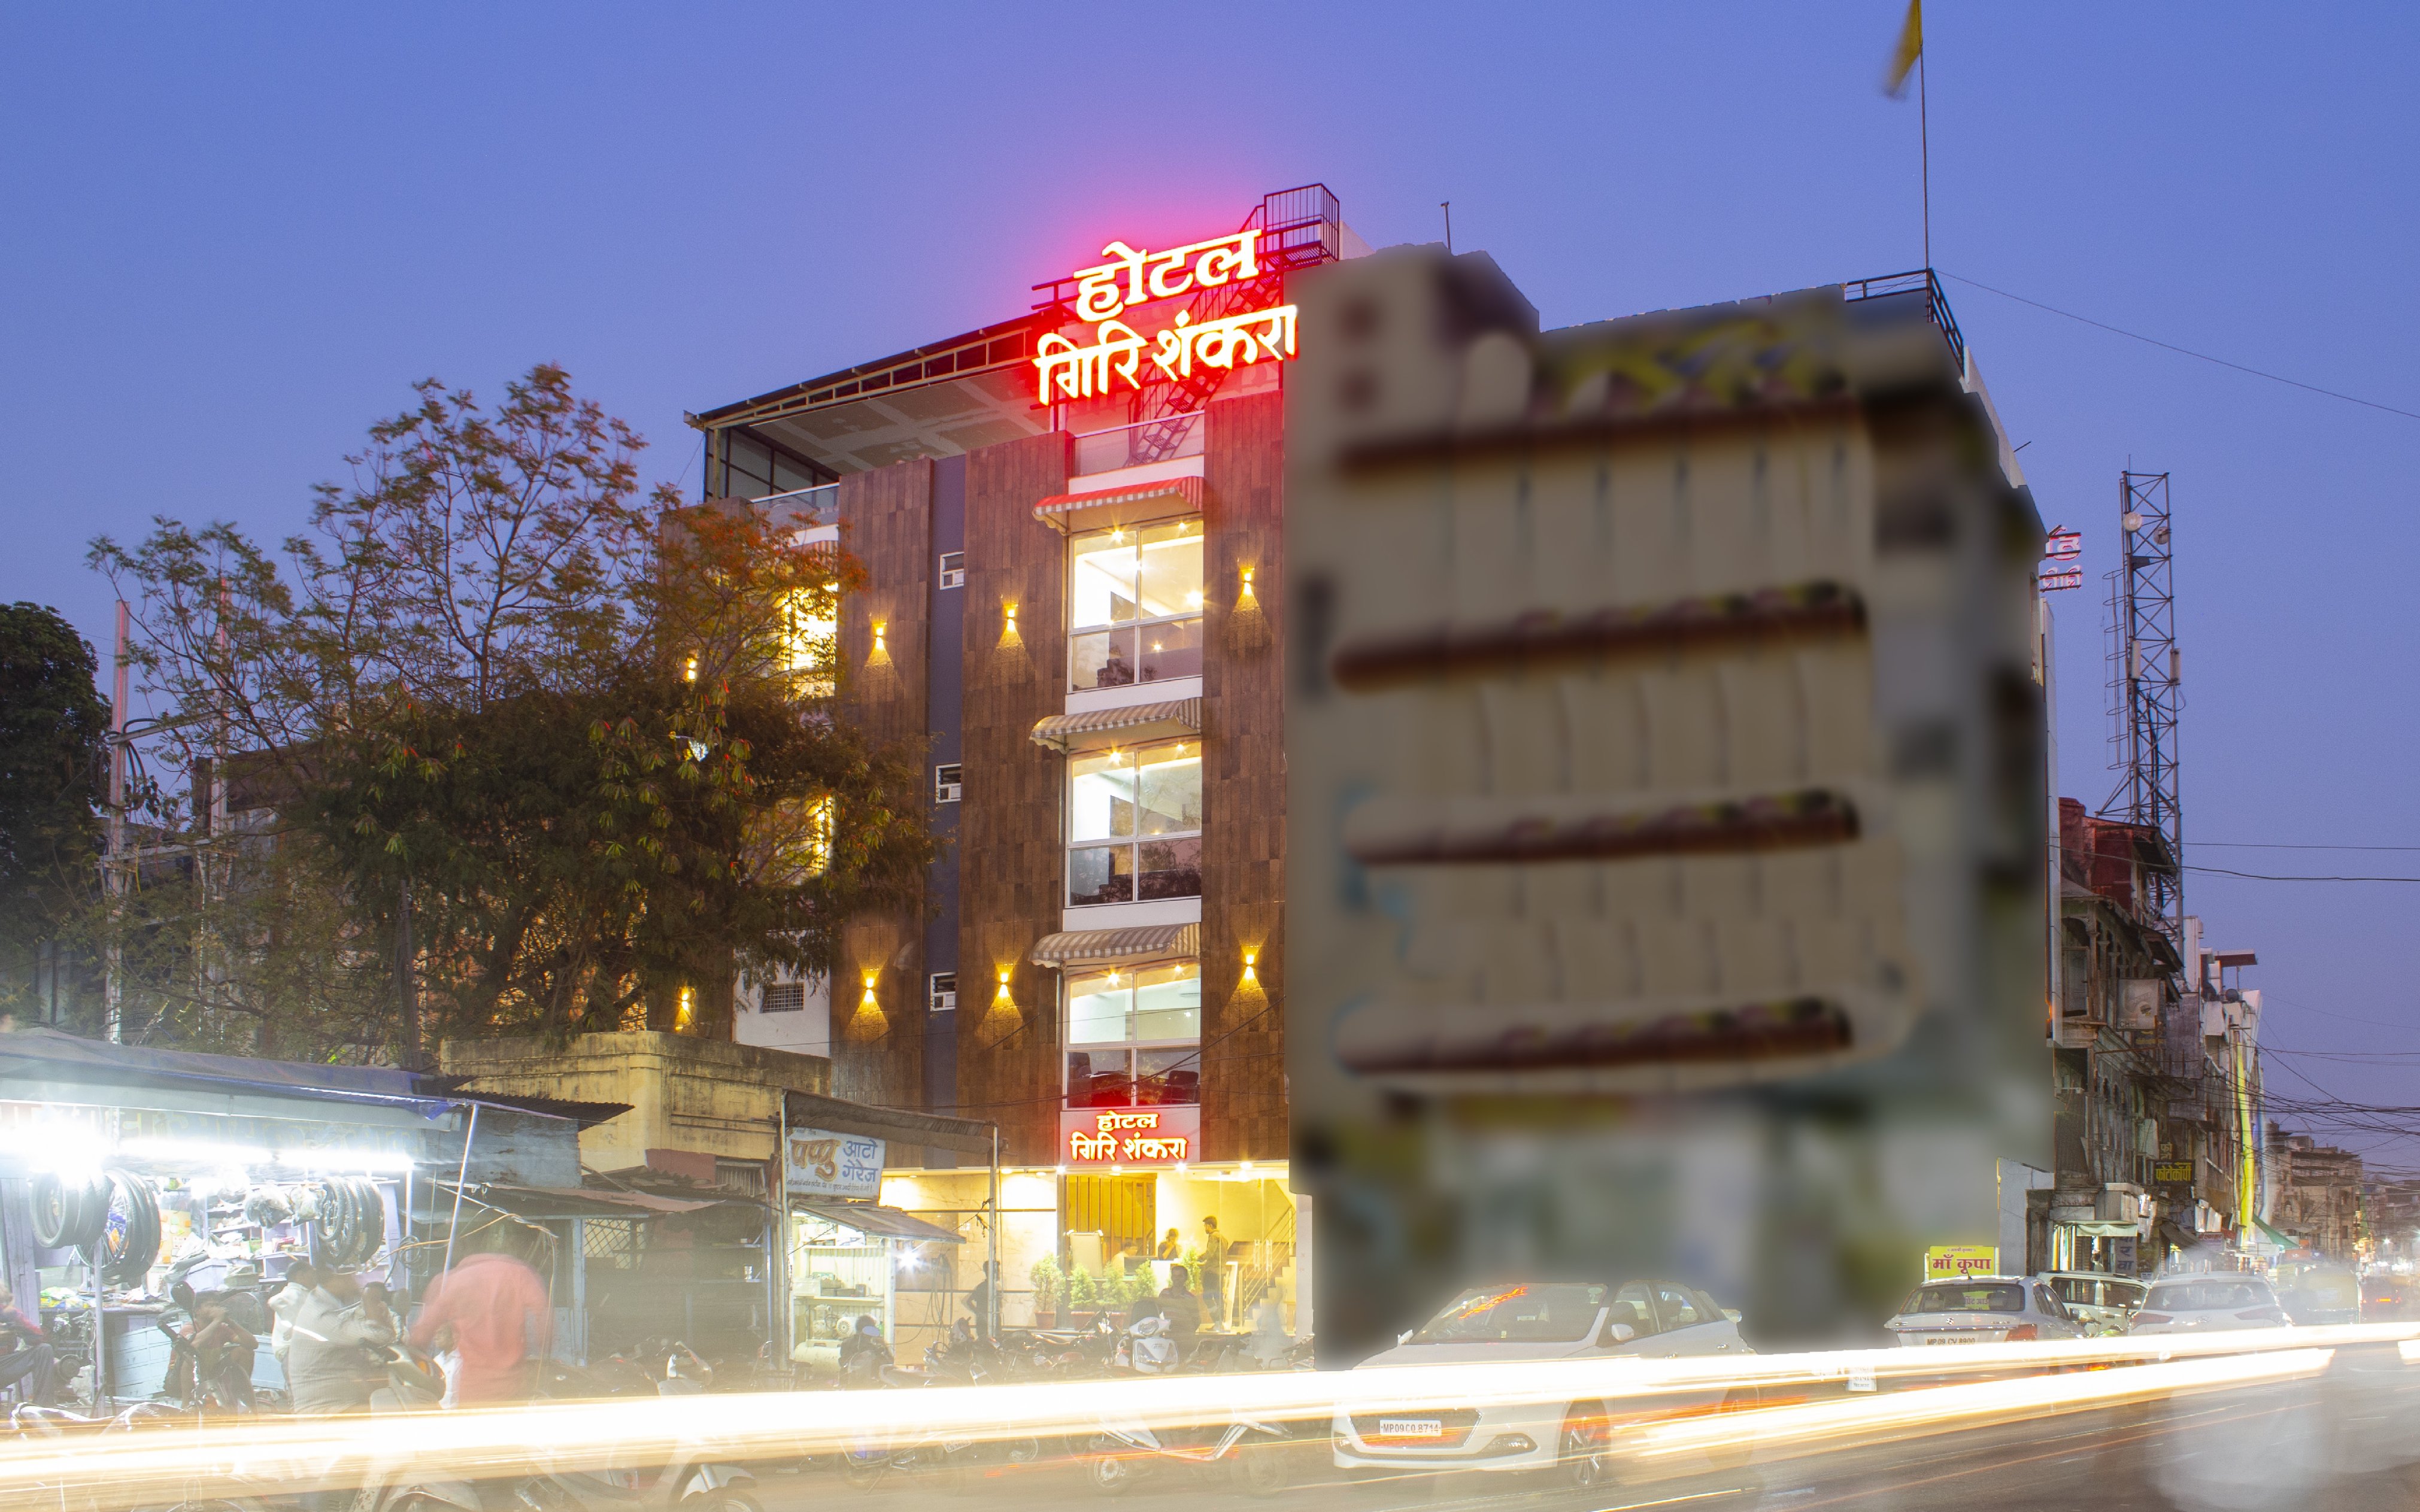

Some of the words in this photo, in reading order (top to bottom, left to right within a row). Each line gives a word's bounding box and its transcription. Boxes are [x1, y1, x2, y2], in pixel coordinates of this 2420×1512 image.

[1073, 229, 1261, 322] होटल
[1032, 320, 1148, 406] गिरि
[1151, 304, 1298, 382] शंकरा
[1096, 1110, 1159, 1133] होटल
[1069, 1131, 1119, 1161] गिरि
[1122, 1131, 1188, 1160] शंकरा
[1933, 1253, 1954, 1270] माँ
[1957, 1259, 1992, 1274] कृपा
